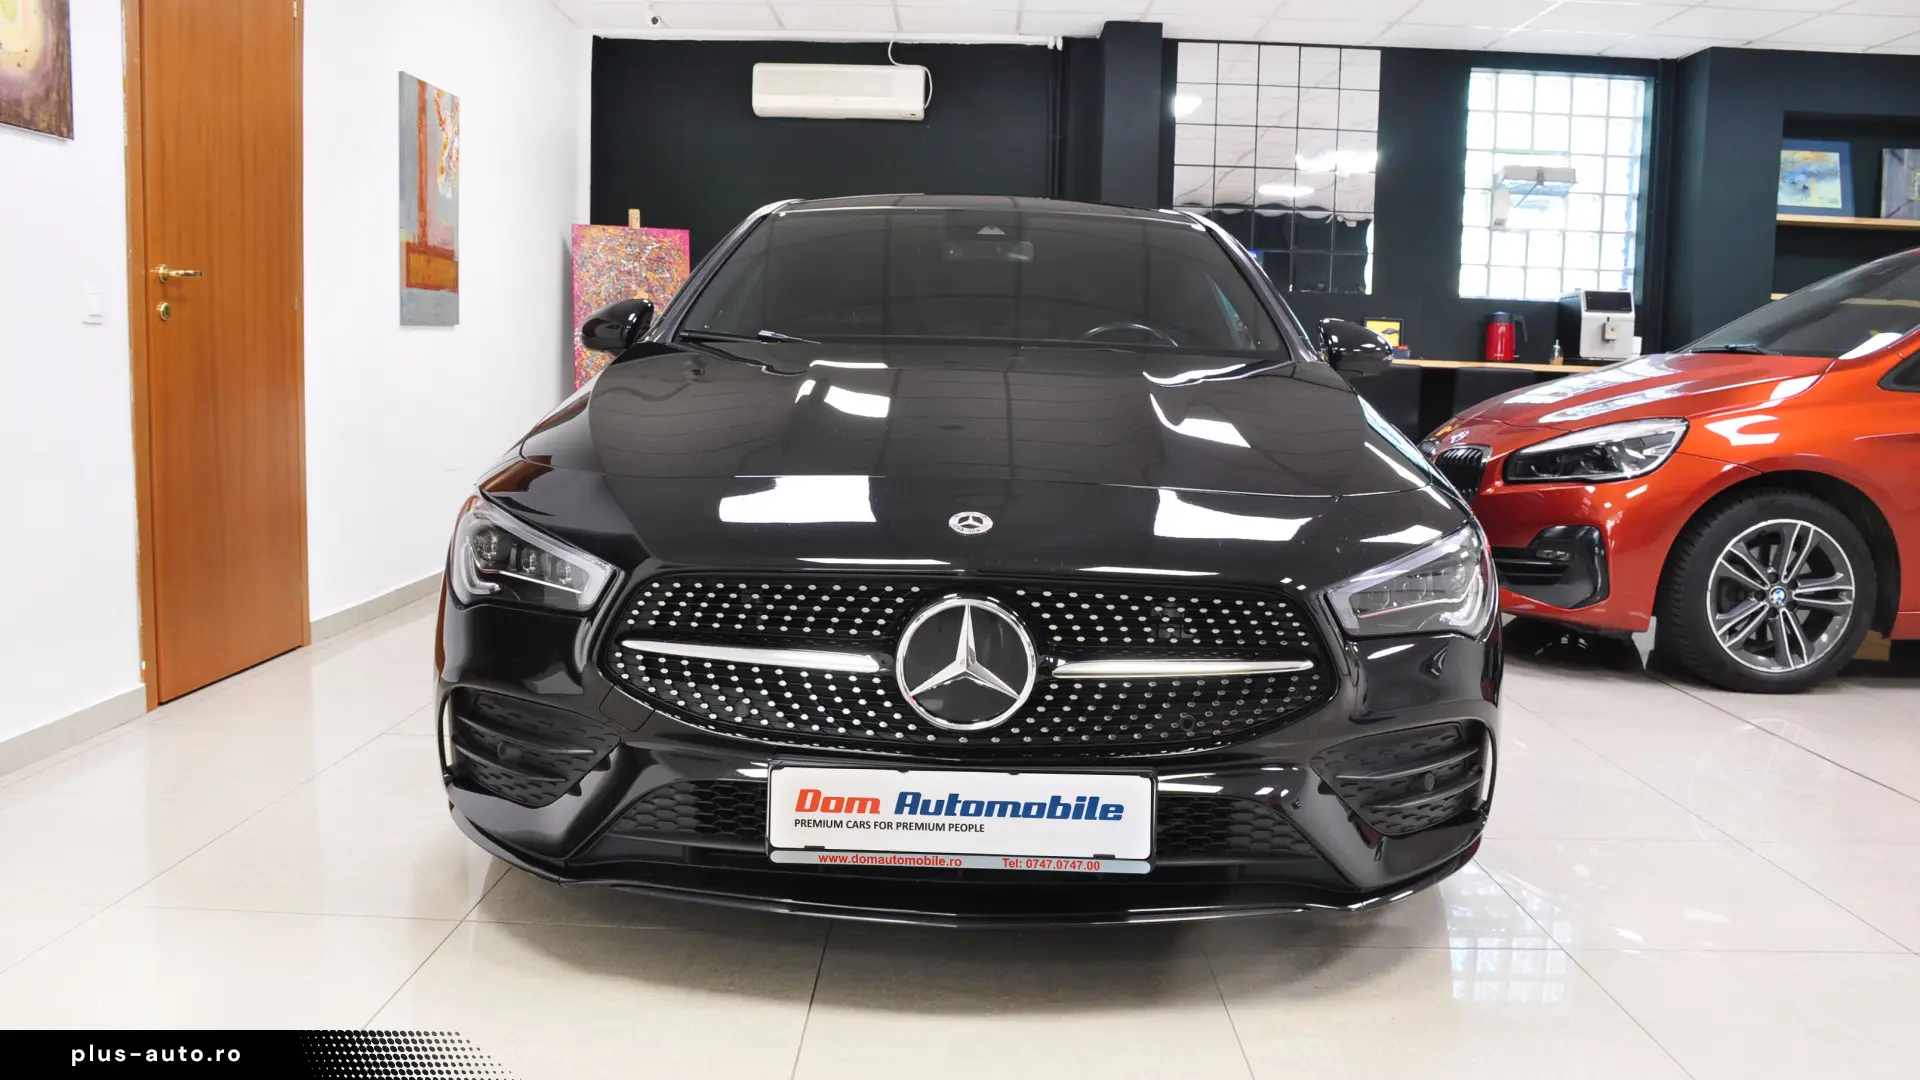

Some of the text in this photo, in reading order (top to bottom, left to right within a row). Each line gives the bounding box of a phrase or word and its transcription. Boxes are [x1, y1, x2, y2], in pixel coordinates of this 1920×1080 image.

[795, 788, 1125, 822] Dom Automobile
[794, 818, 985, 833] PREMIUM CARS FOR PREMIUM PEOPLE
[818, 853, 1101, 872] www.domautomobile.ro Tel: 0747.0747.00
